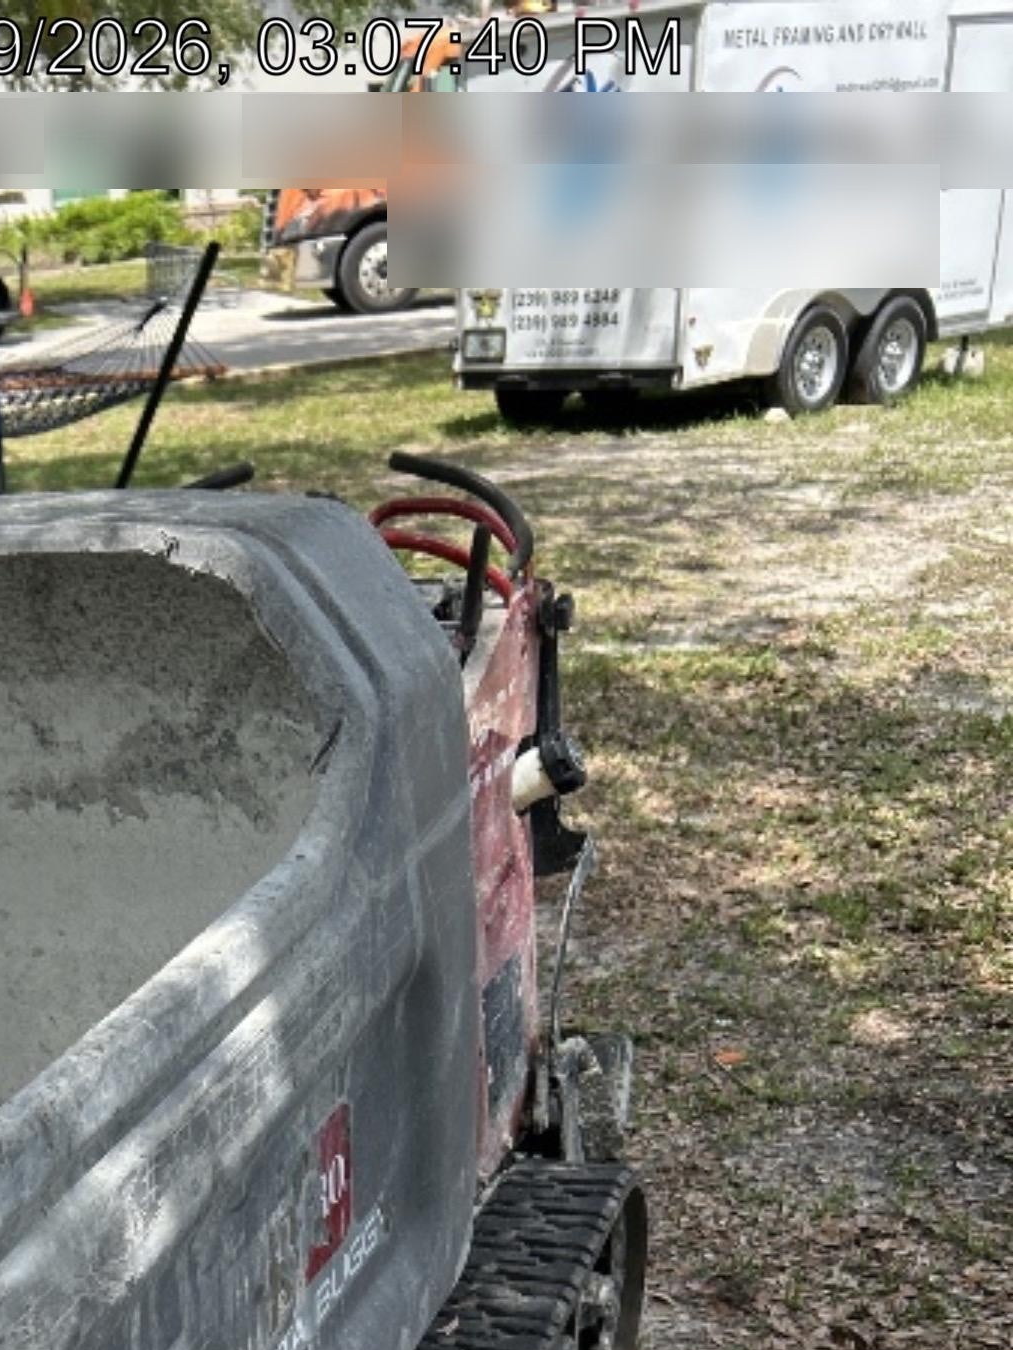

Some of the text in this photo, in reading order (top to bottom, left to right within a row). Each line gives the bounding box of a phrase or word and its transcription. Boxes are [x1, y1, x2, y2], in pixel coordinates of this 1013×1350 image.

[723, 20, 927, 48] METAL FRAMING AND DRYWALL
